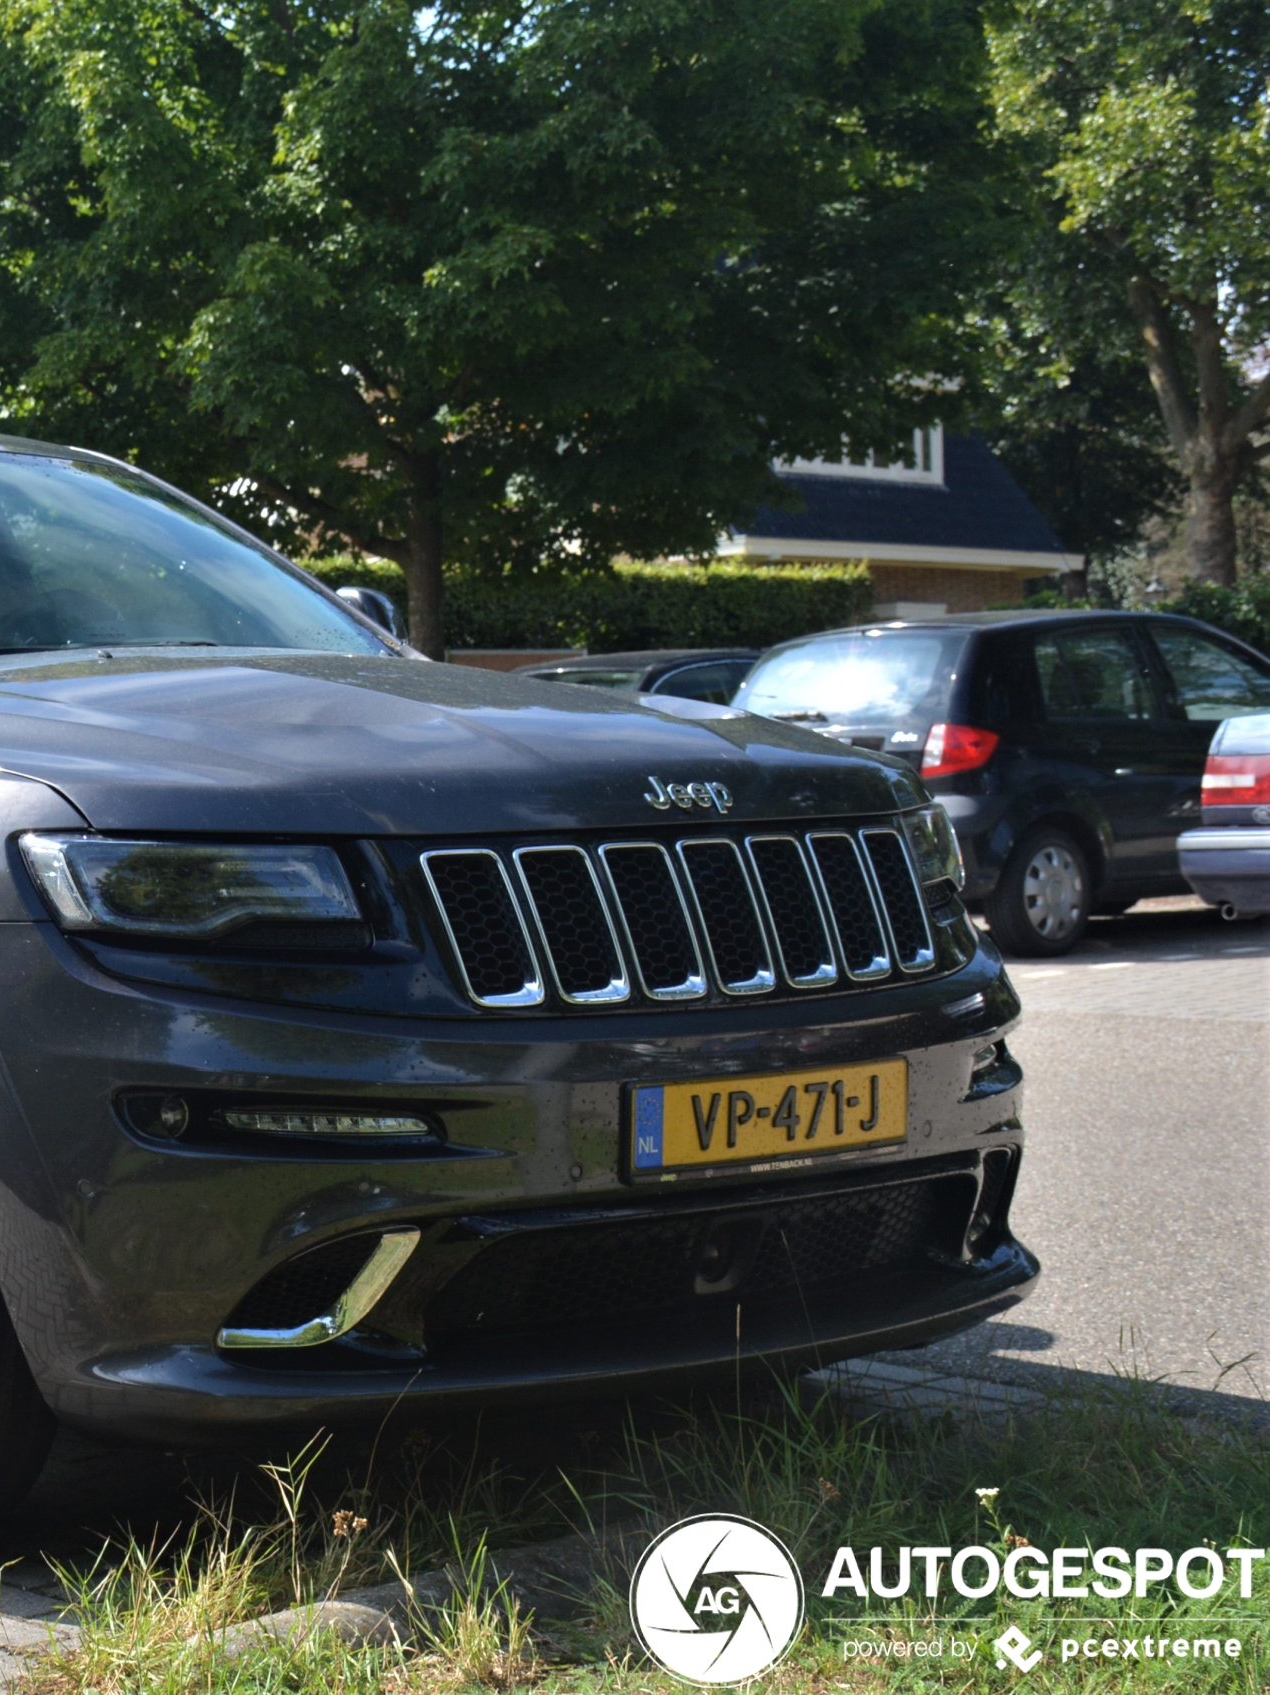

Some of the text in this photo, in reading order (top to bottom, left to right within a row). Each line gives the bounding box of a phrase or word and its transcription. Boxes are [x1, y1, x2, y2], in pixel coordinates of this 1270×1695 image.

[643, 776, 733, 814] Jeep
[691, 1075, 879, 1150] VP-471-J
[639, 1136, 658, 1154] NL
